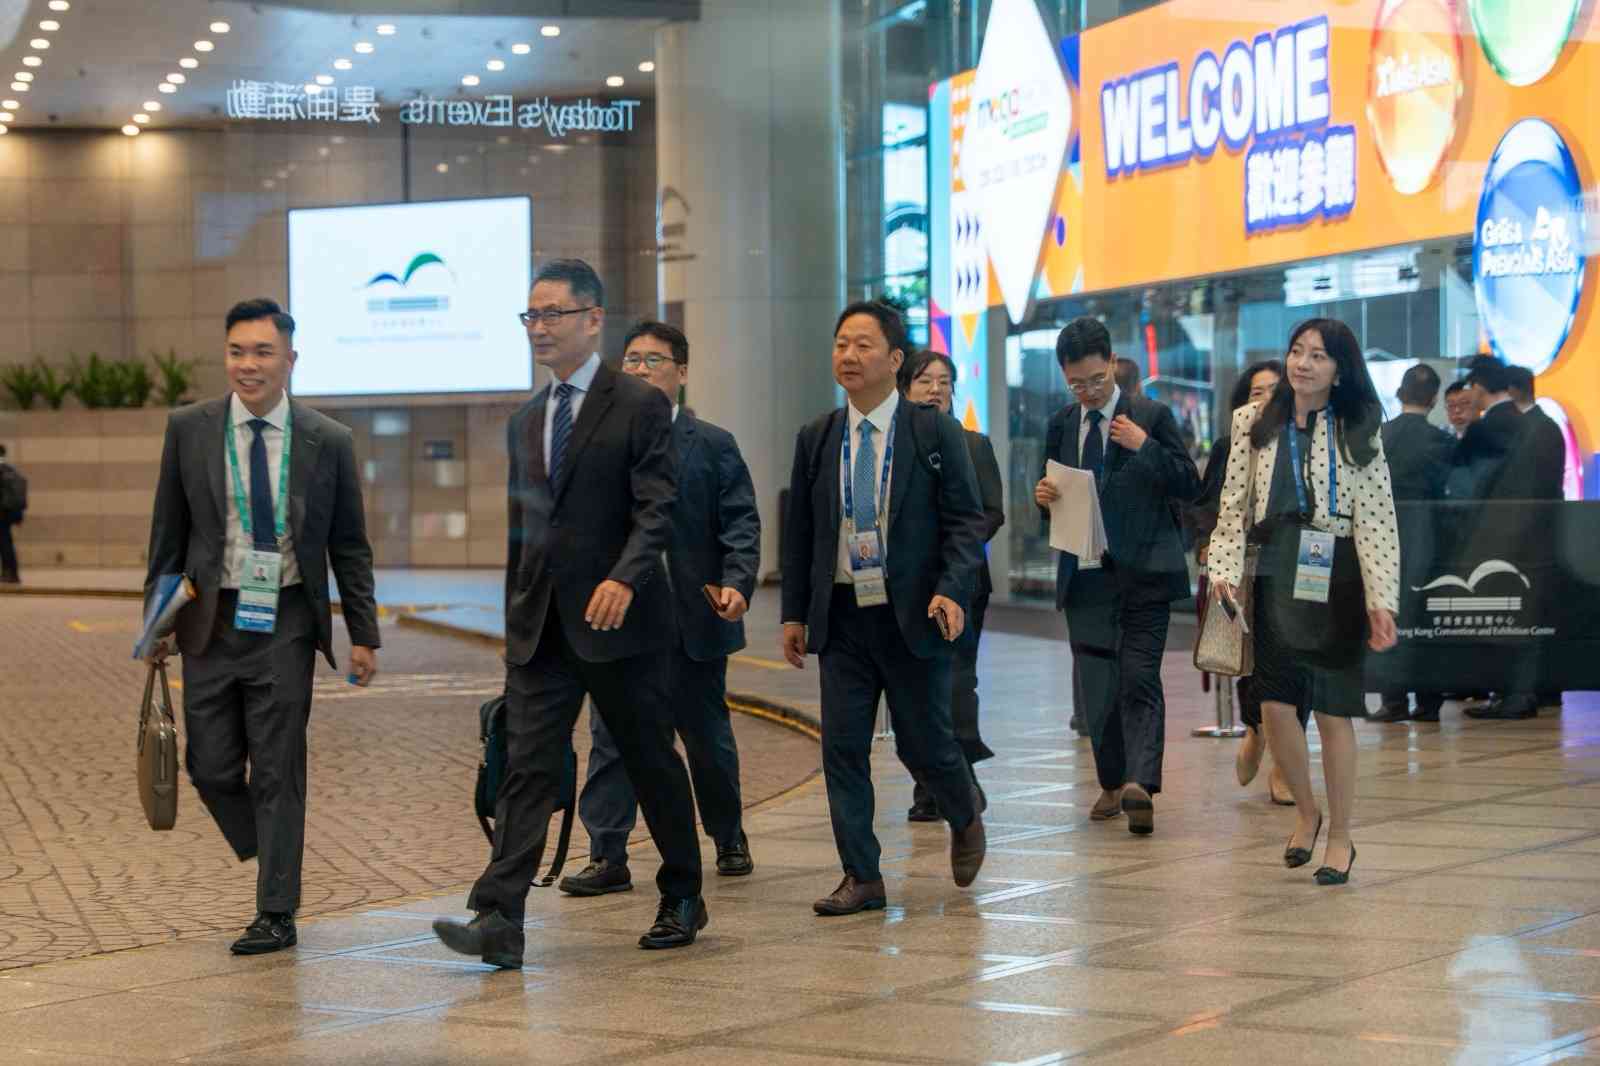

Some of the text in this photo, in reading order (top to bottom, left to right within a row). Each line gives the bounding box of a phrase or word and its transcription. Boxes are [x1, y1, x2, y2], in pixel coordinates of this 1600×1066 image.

[1101, 15, 1328, 177] WELCOME
[1414, 627, 1433, 639] Kong
[1434, 626, 1476, 636] Convention
[1478, 626, 1491, 636] and
[1492, 626, 1529, 636] Exhibition
